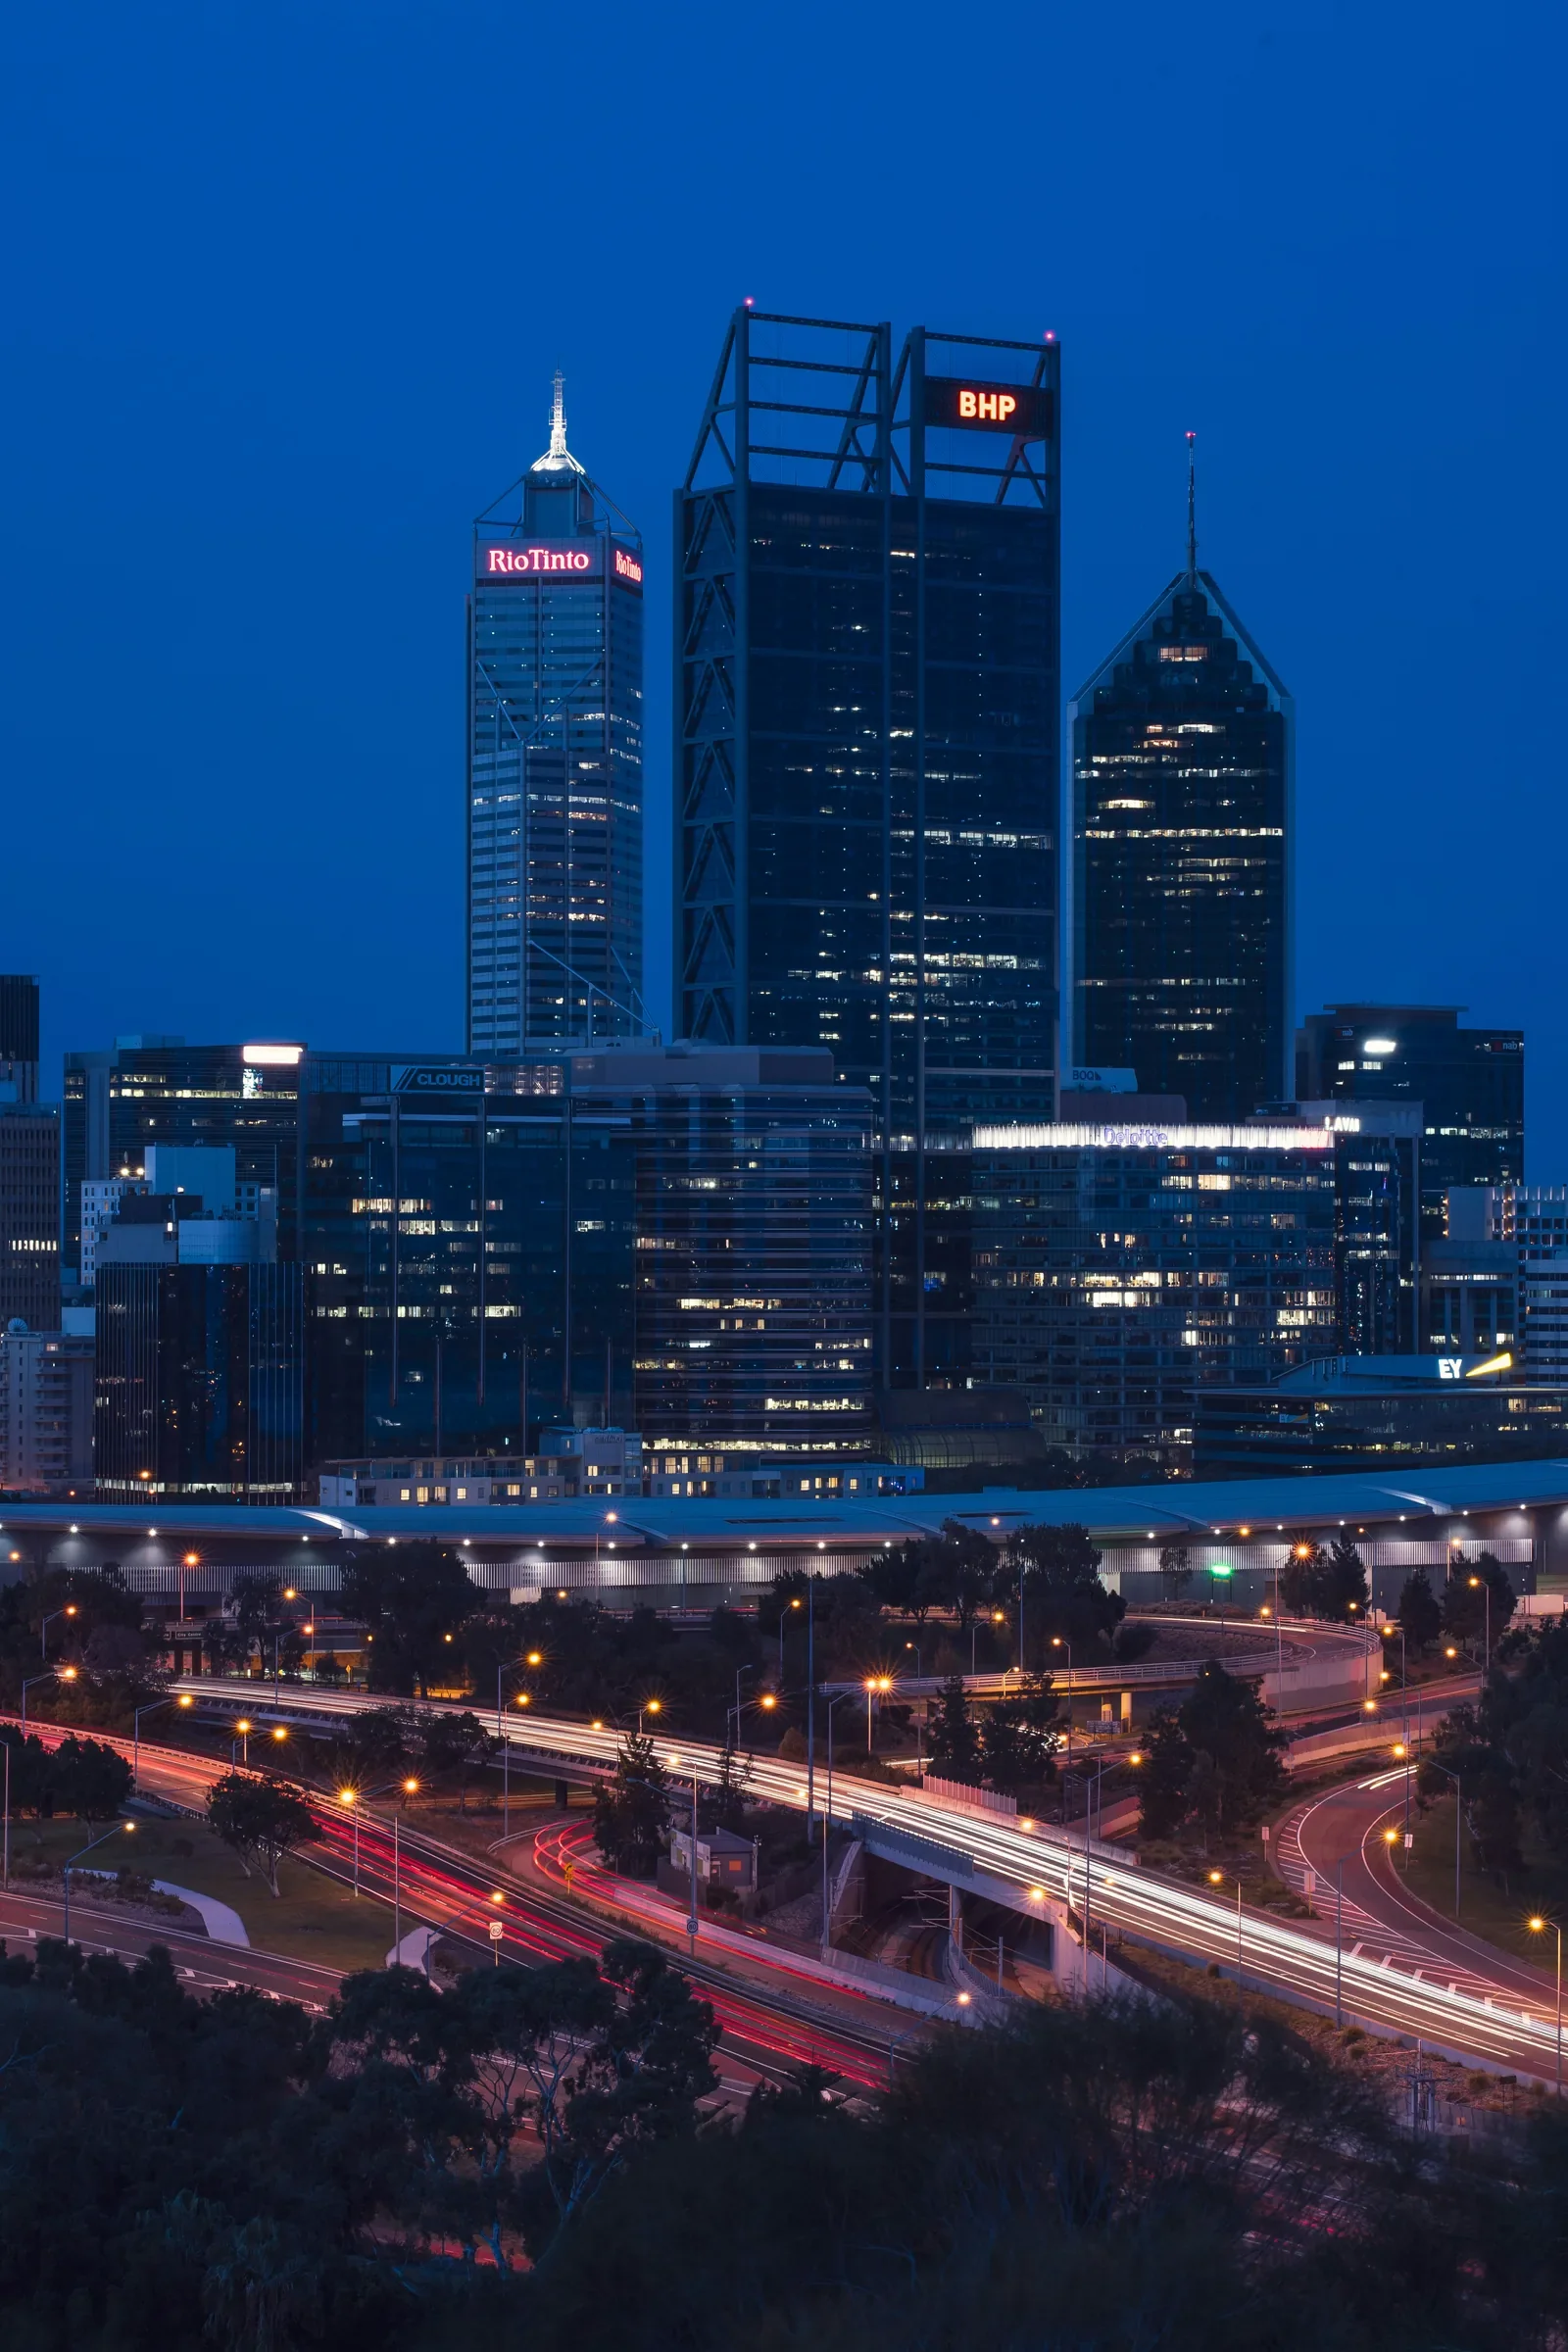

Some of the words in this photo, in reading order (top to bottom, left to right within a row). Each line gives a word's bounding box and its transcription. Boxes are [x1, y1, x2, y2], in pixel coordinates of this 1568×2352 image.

[959, 391, 1016, 421] BHP
[1502, 1040, 1518, 1051] nab
[416, 1073, 480, 1087] CLOUGH
[1072, 1069, 1095, 1081] BOQ
[1103, 1127, 1168, 1146] Deloitte
[1438, 1358, 1463, 1379] EY
